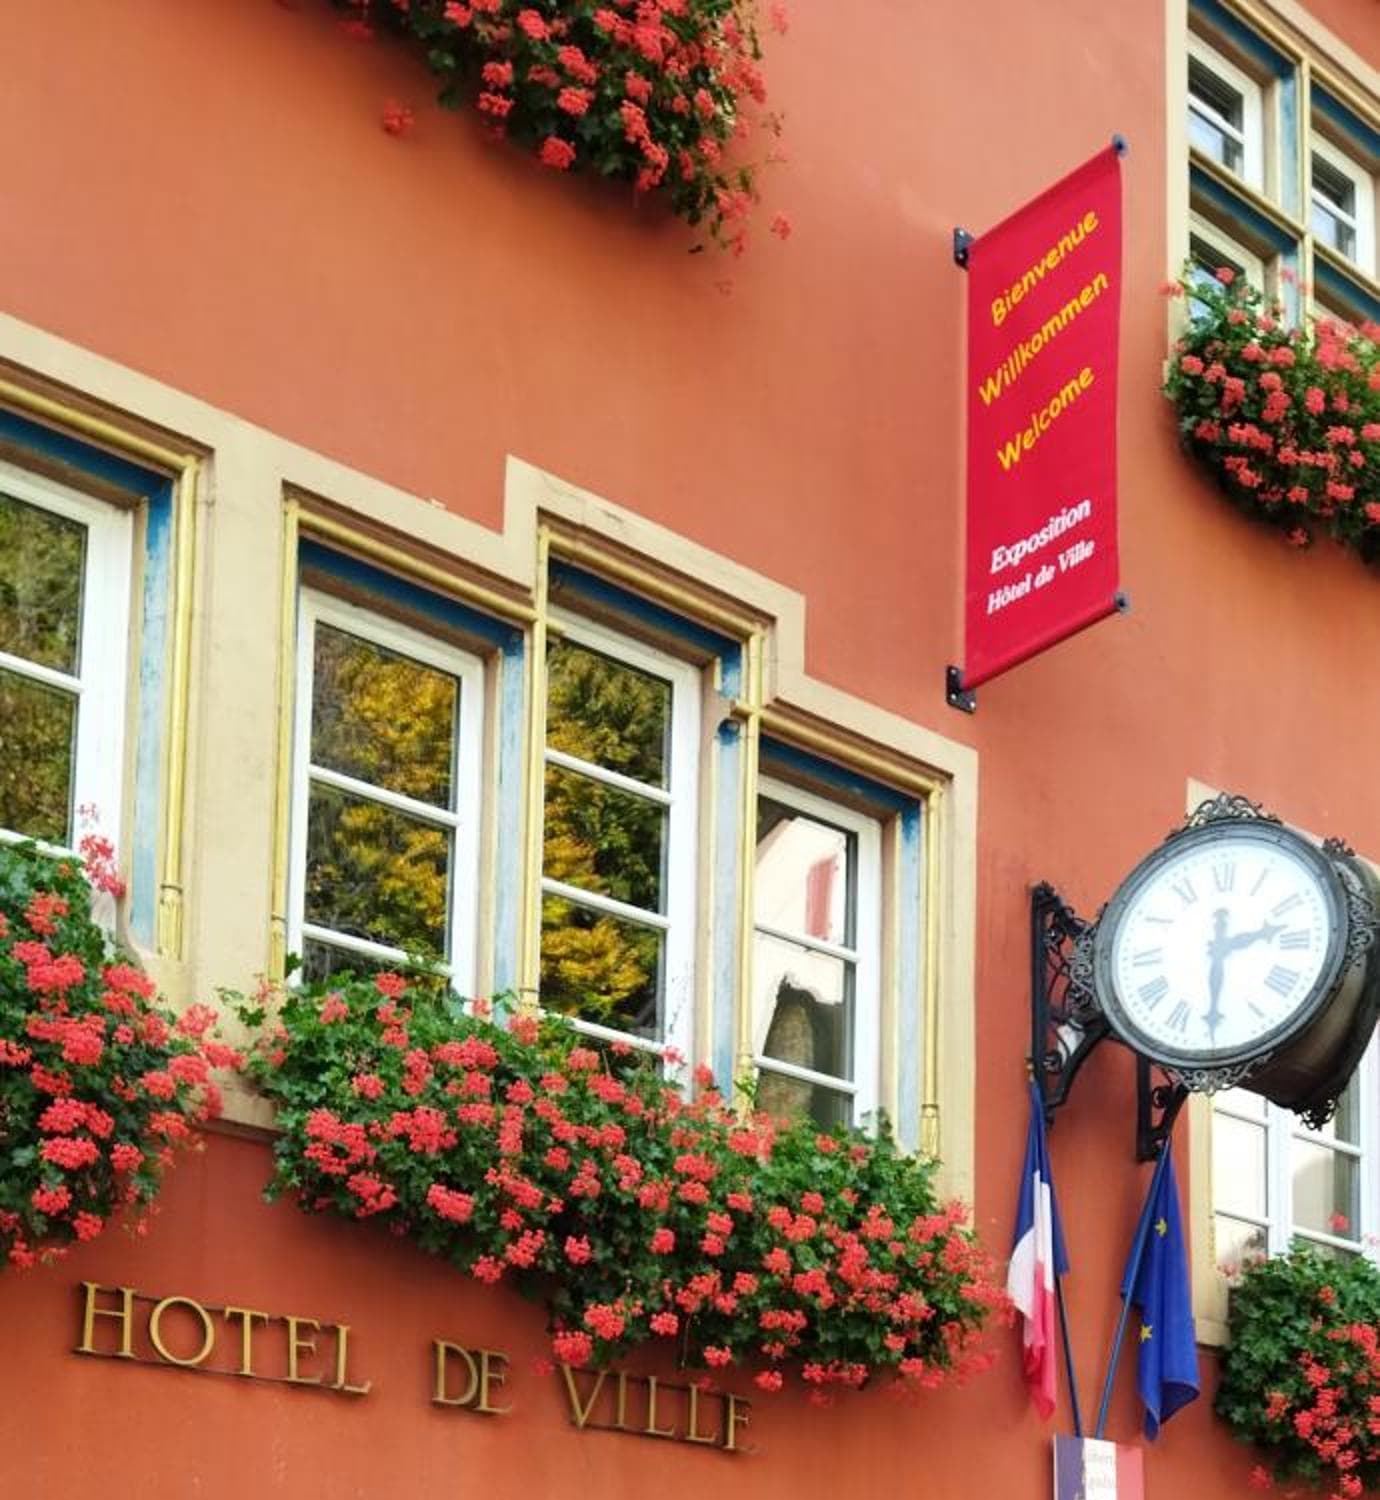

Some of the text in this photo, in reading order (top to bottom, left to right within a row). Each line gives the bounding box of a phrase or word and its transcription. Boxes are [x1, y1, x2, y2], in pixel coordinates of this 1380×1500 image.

[991, 210, 1099, 326] Bienvenue
[979, 272, 1109, 406] Willkommen
[997, 366, 1095, 470] Welcome
[990, 499, 1091, 574] Exposition
[1033, 564, 1056, 589] de
[1057, 539, 1095, 573] Ville
[76, 1280, 755, 1452] HOTEL DE VILLE
